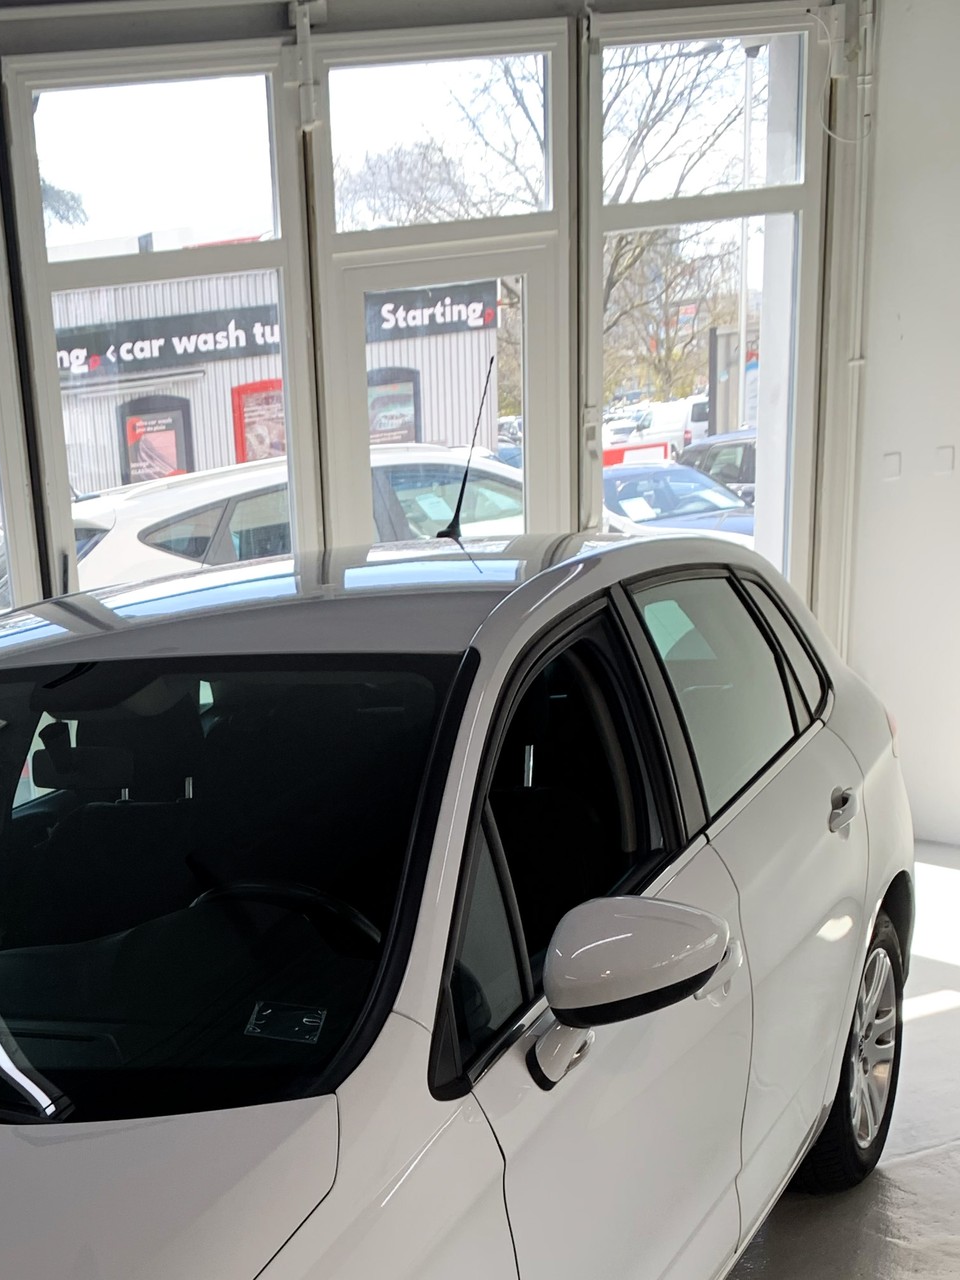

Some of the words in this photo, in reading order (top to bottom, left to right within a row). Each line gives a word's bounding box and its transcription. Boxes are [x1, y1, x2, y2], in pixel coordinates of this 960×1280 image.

[381, 296, 484, 329] Starting
[119, 337, 165, 362] car
[172, 318, 247, 355] wash
